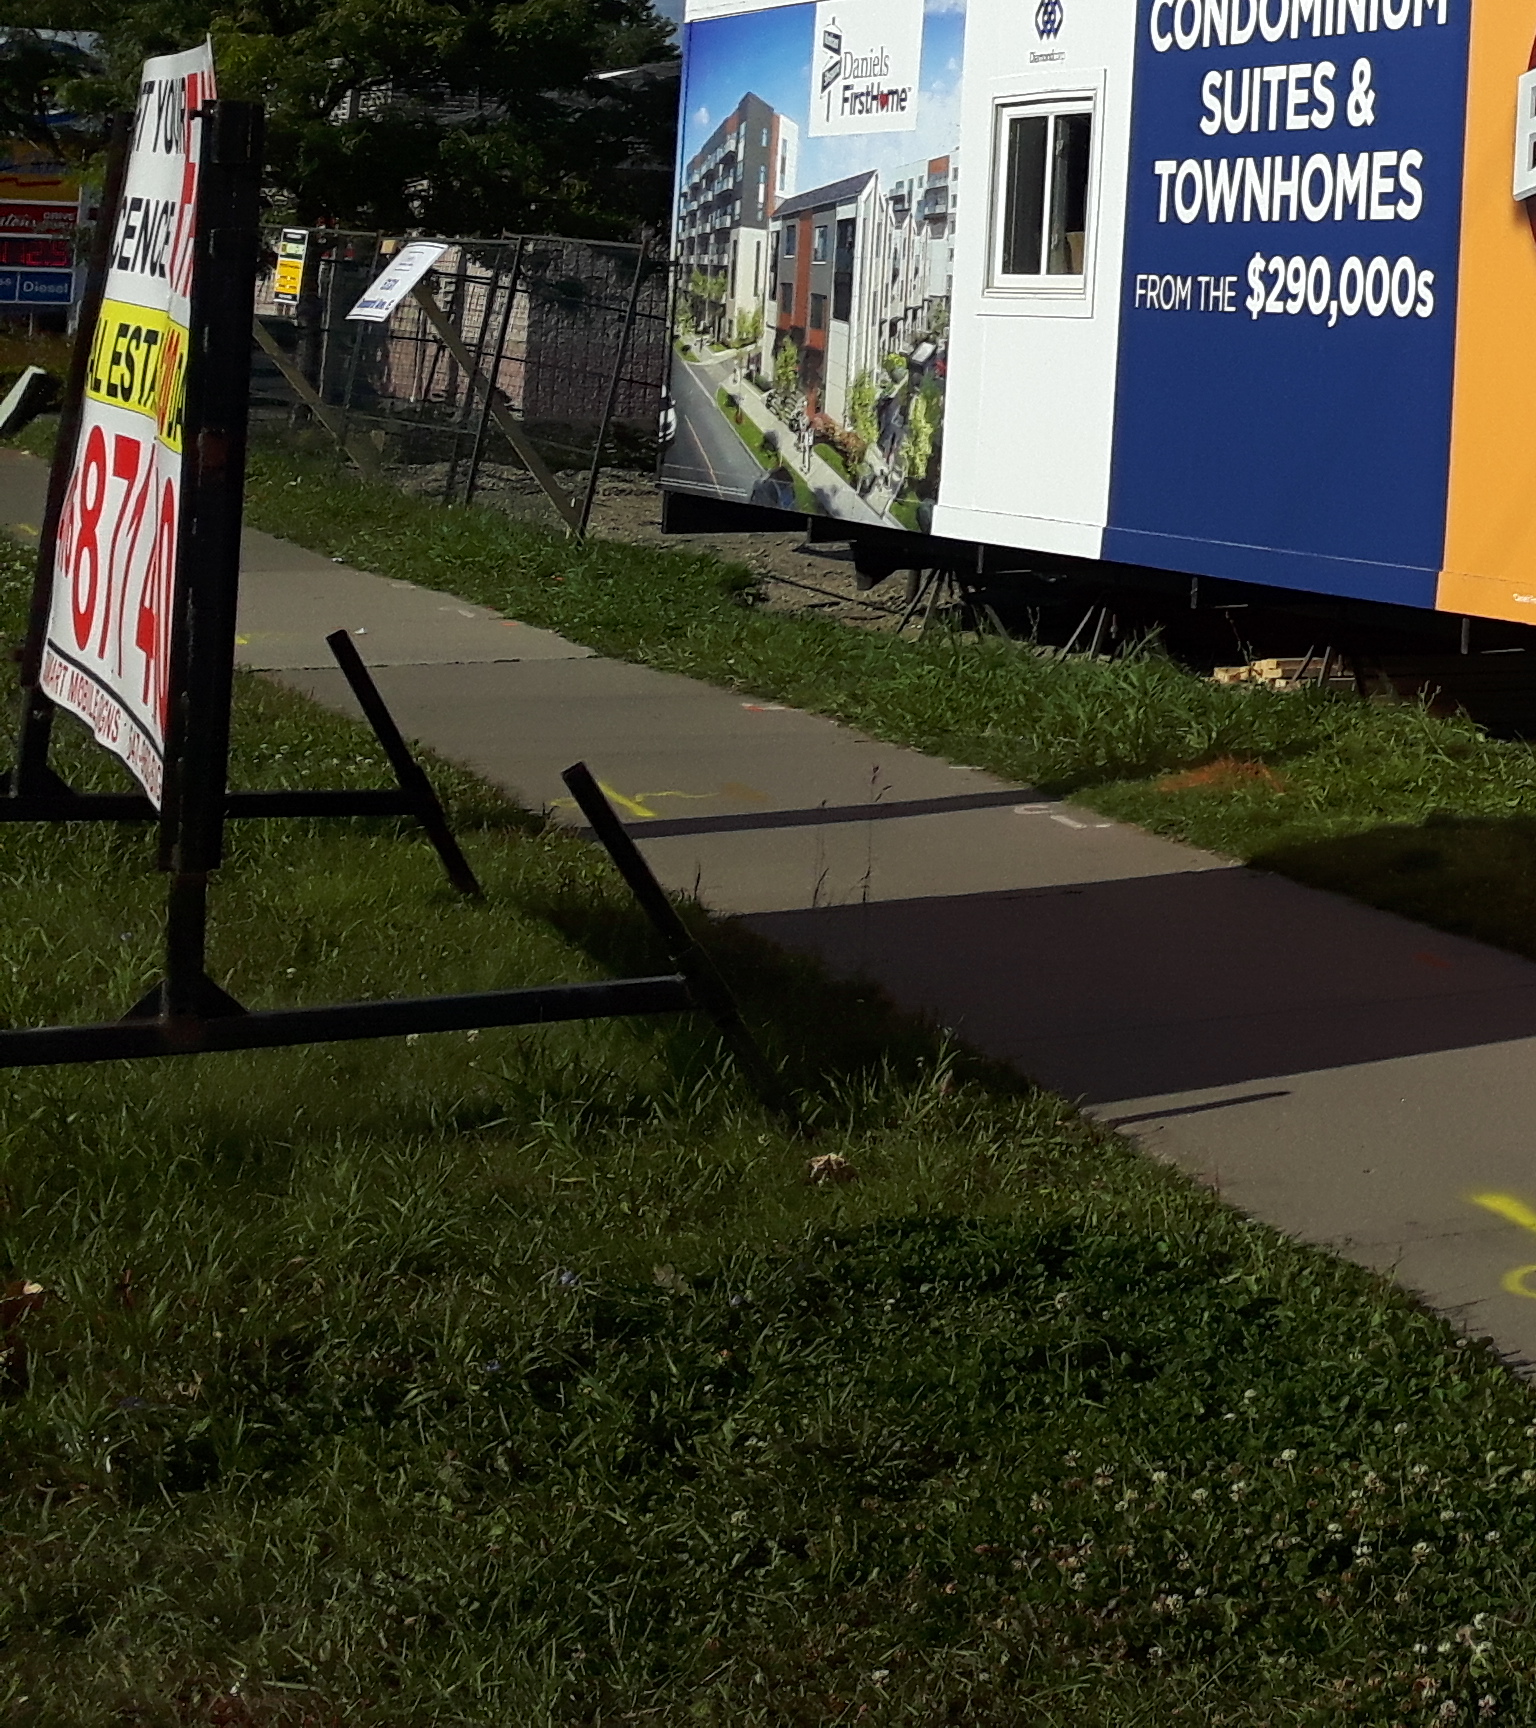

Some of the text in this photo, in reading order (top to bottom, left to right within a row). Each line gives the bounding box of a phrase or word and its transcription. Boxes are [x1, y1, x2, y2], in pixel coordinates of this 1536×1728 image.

[842, 46, 889, 80] Daniels
[1200, 58, 1375, 135] SUITES &
[1155, 150, 1422, 223] TOWNHOMES
[22, 280, 69, 294] Diesel
[1135, 252, 1434, 327] FROM THE $290,000s
